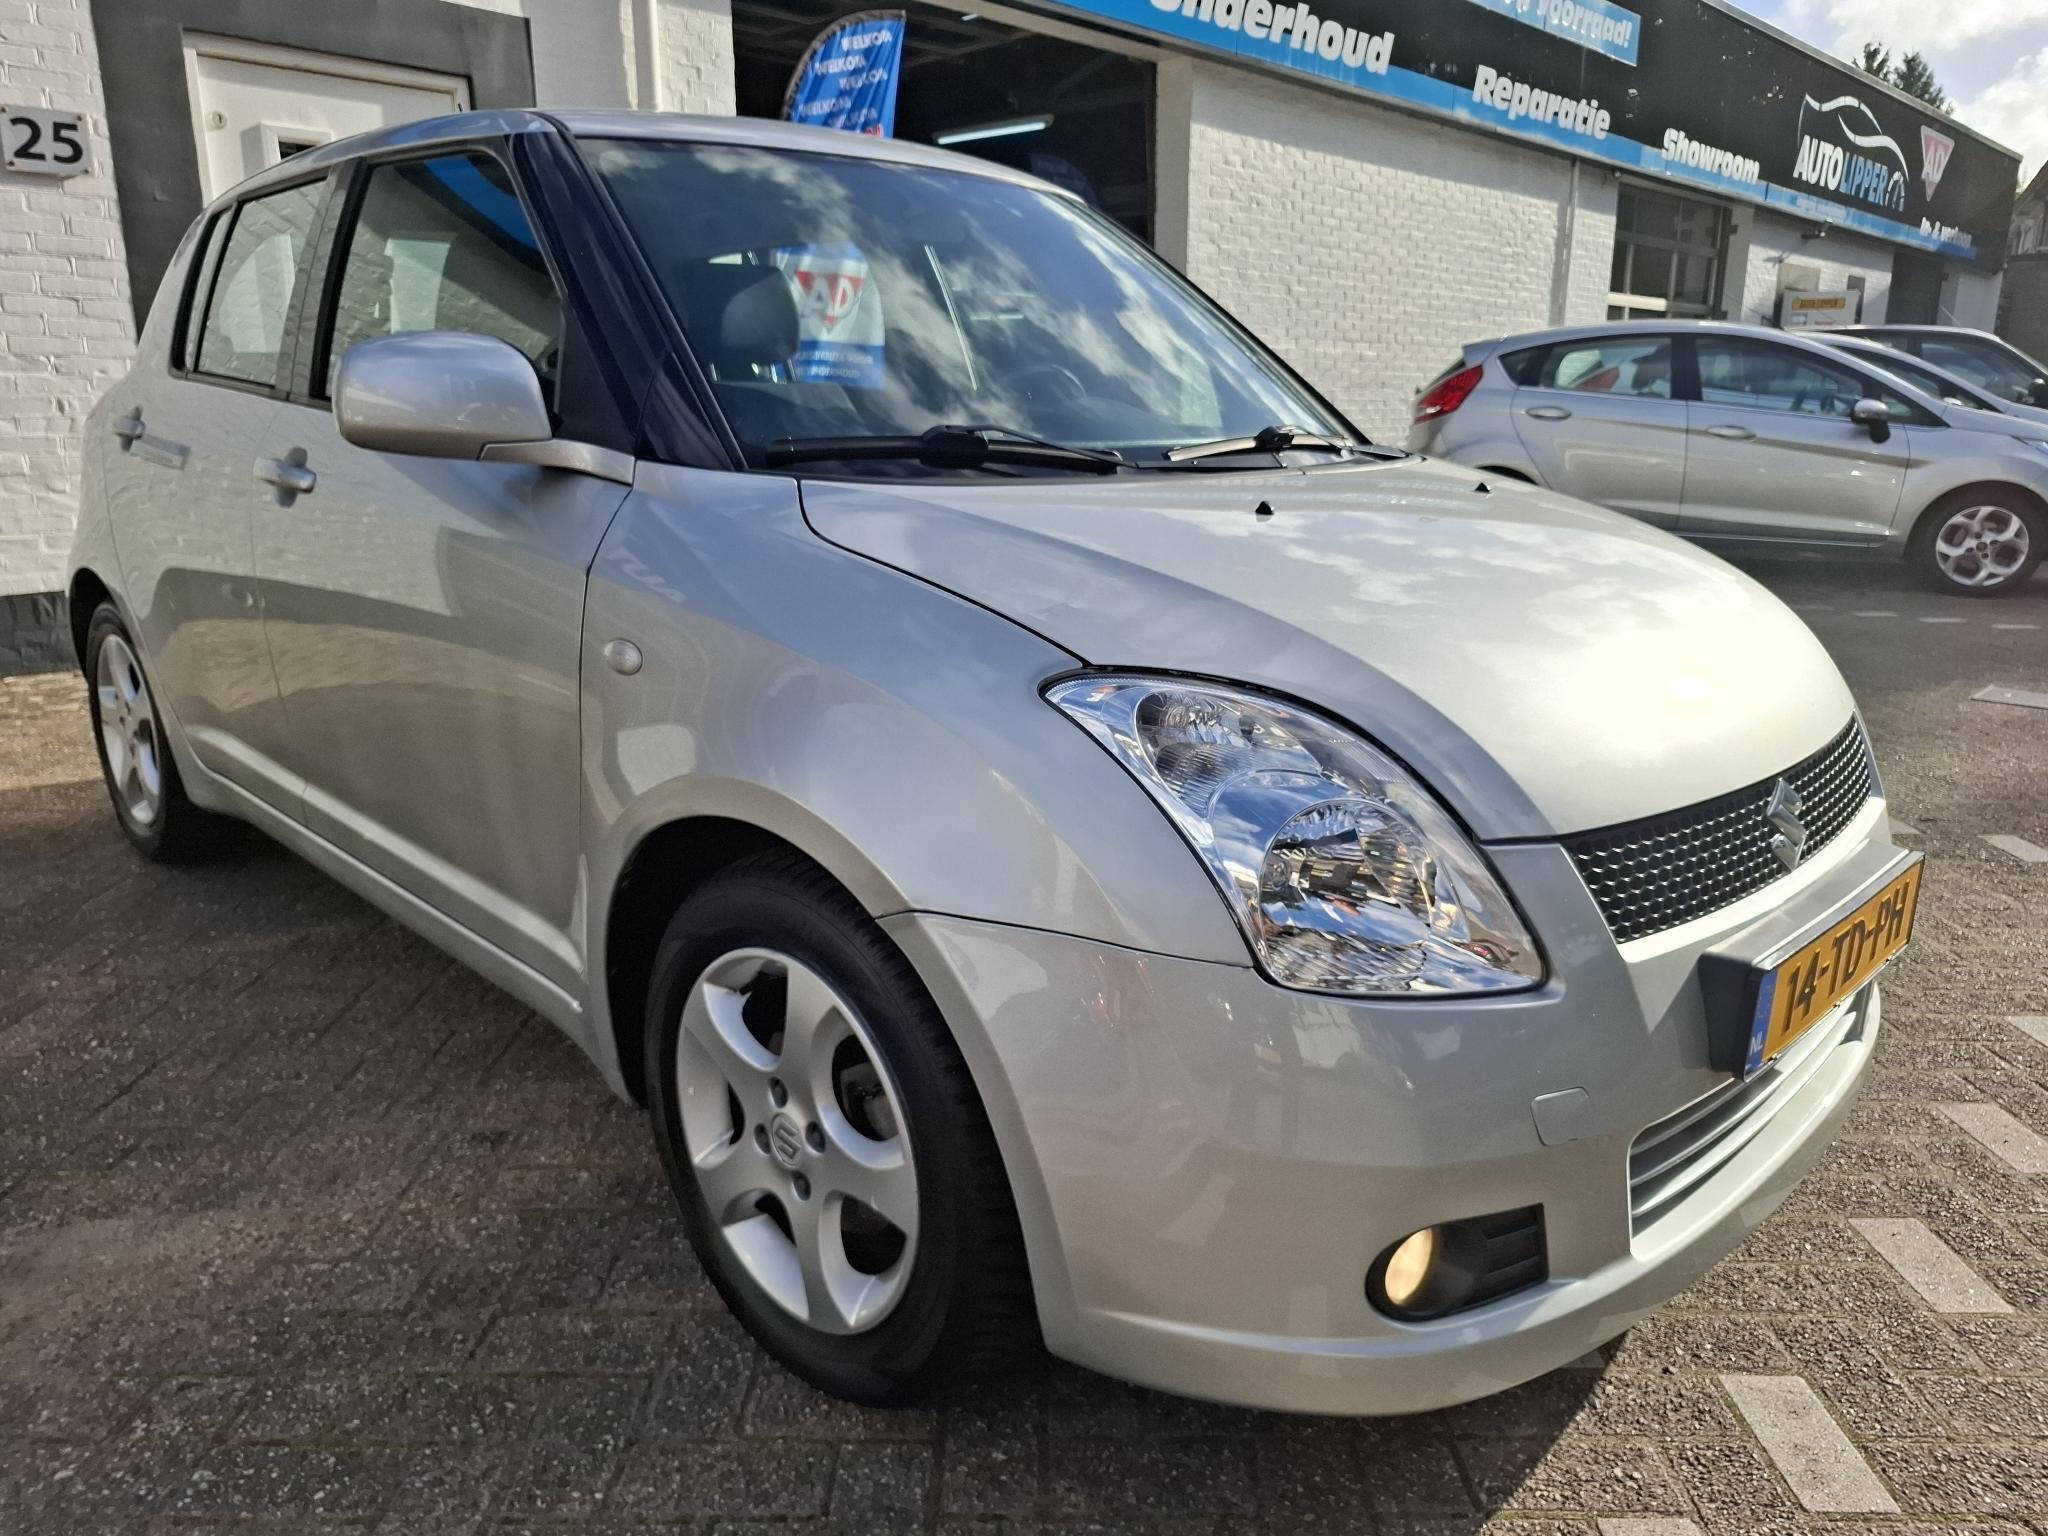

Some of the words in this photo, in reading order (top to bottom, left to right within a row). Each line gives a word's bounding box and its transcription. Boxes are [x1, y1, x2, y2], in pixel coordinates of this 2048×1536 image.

[1149, 0, 1395, 76] nderhoud
[1472, 64, 1611, 140] Reparatie
[9, 117, 83, 164] 25
[1661, 127, 1760, 184] Showroom
[1921, 140, 1947, 184] AD
[799, 274, 861, 319] AD
[1781, 879, 1911, 1036] 14-TD-PH
[1749, 1031, 1764, 1056] NL
